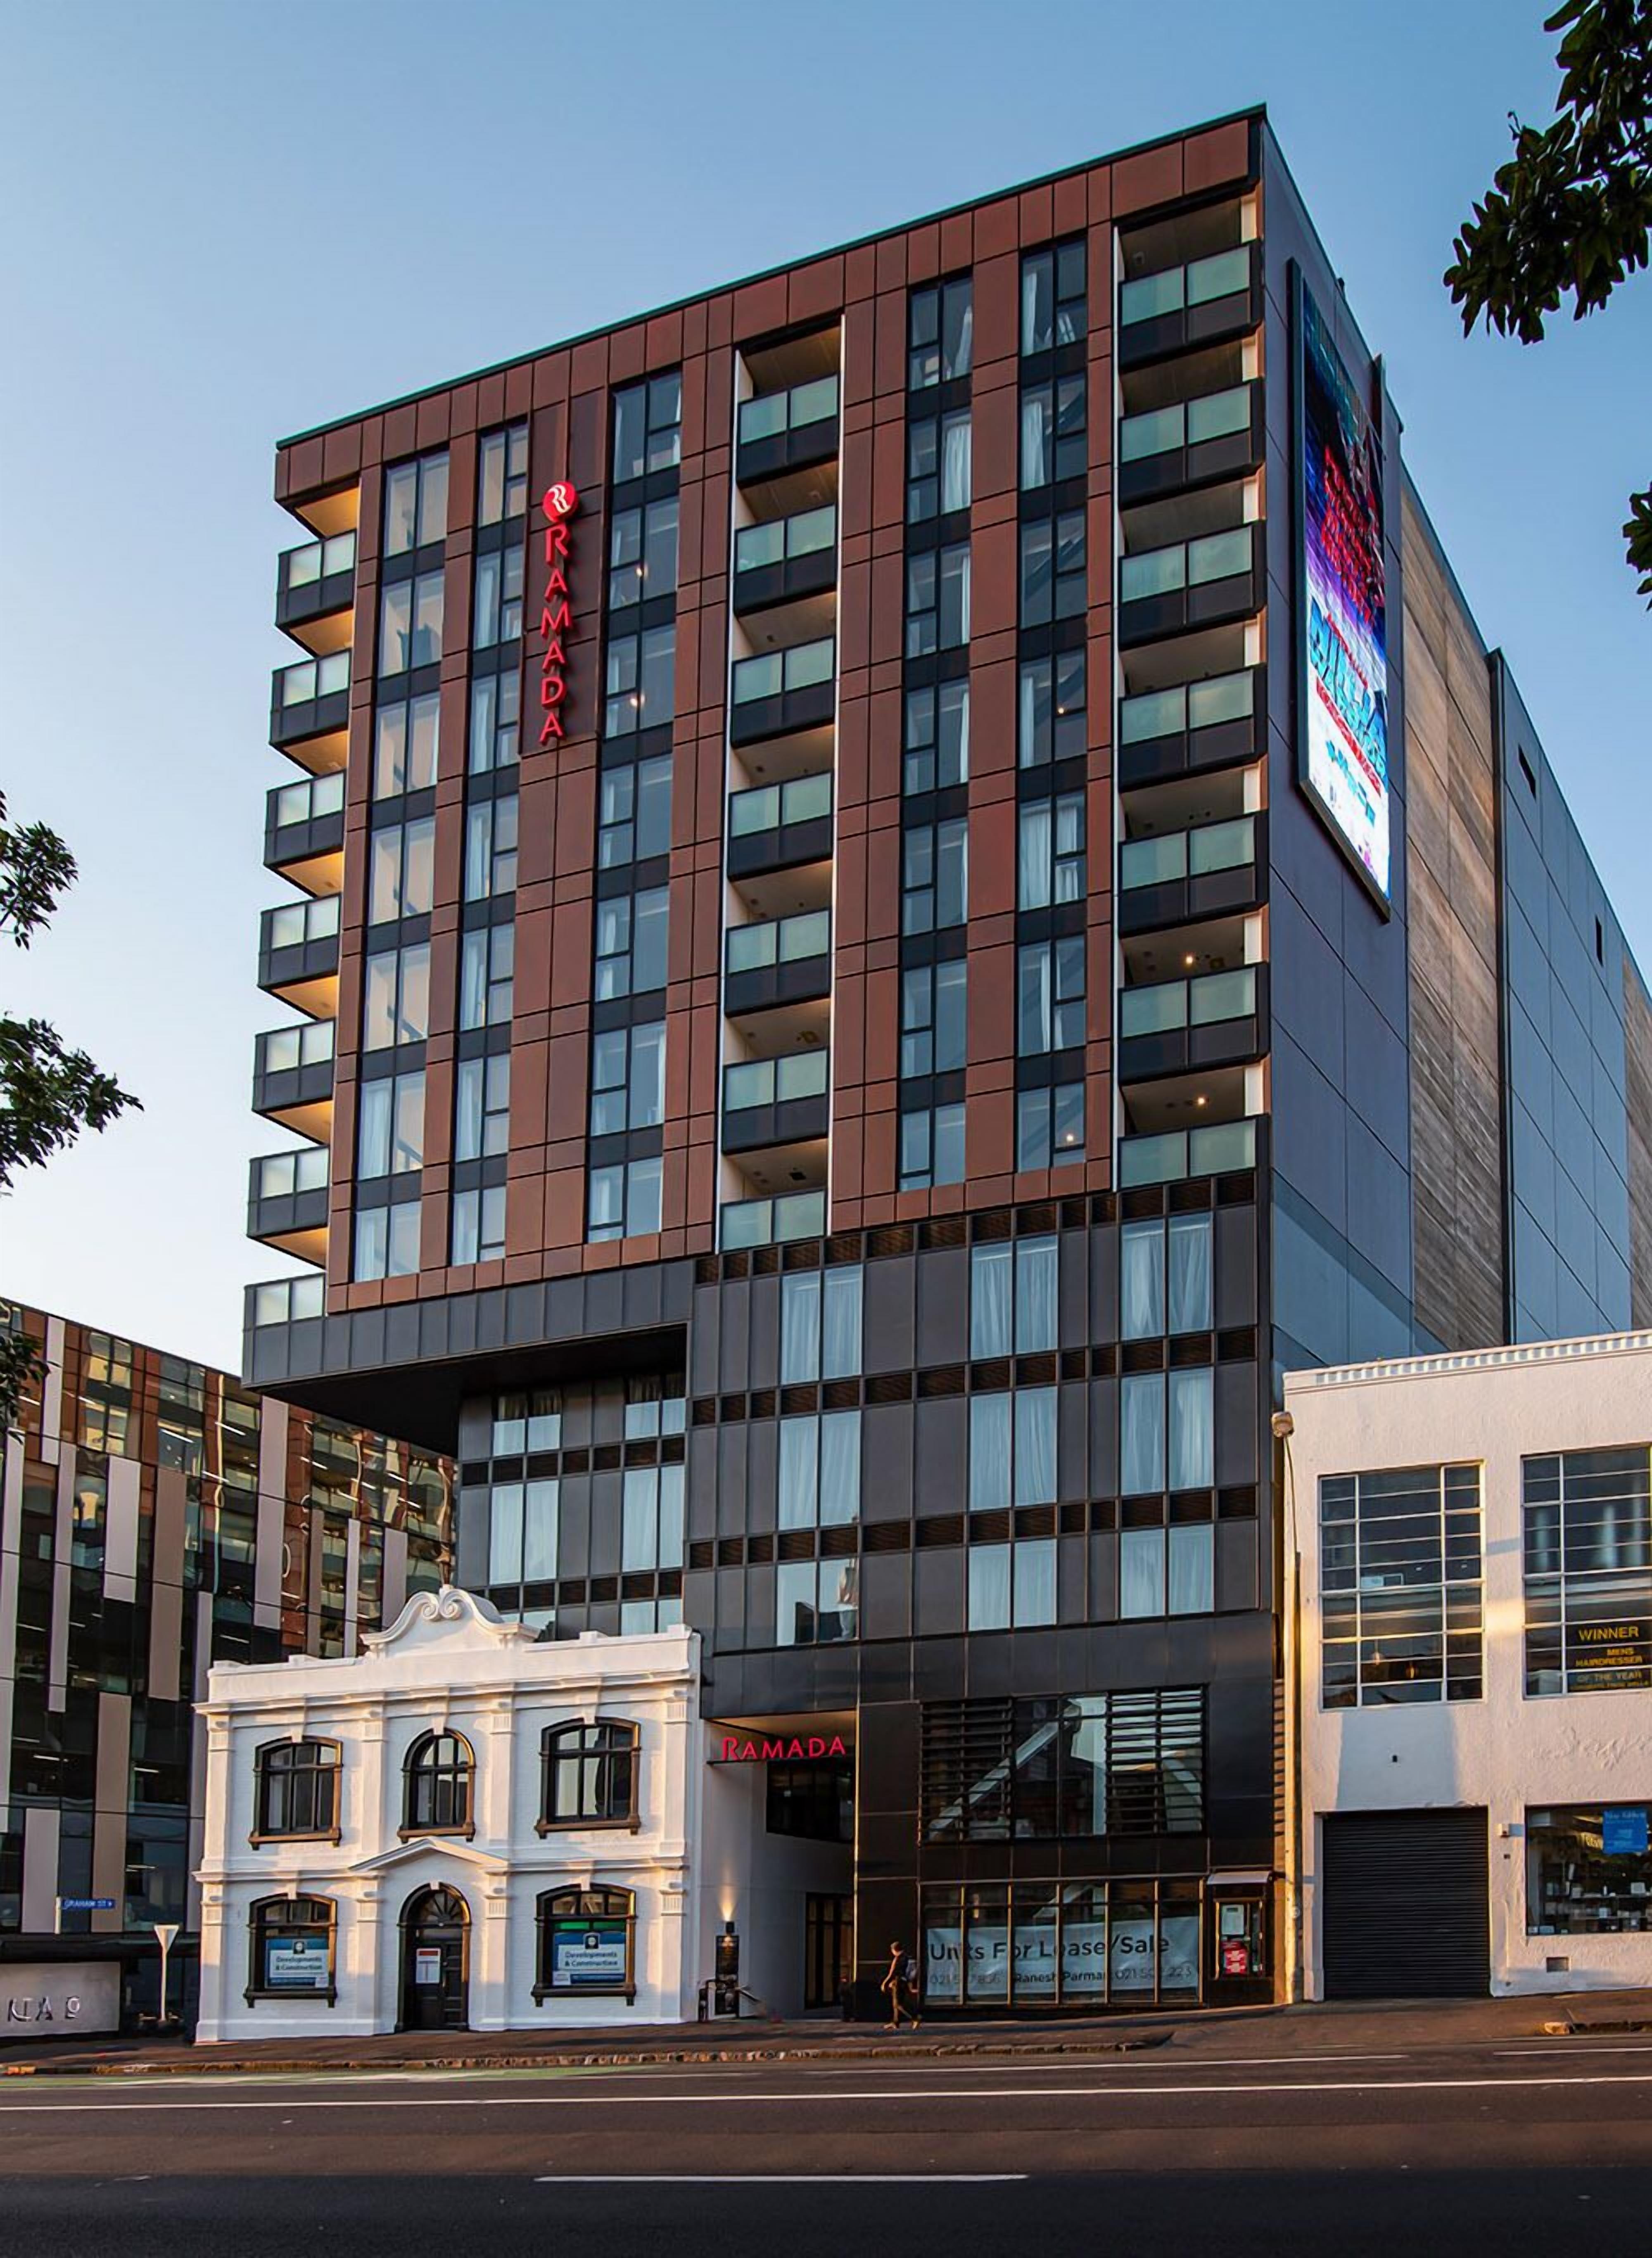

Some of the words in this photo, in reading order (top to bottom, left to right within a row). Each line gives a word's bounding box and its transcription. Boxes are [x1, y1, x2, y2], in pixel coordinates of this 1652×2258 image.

[539, 522, 573, 746] RAMADA
[1578, 1626, 1639, 1641] WINNER
[722, 1736, 846, 1761] RAMADA
[930, 1942, 985, 1960] Uns
